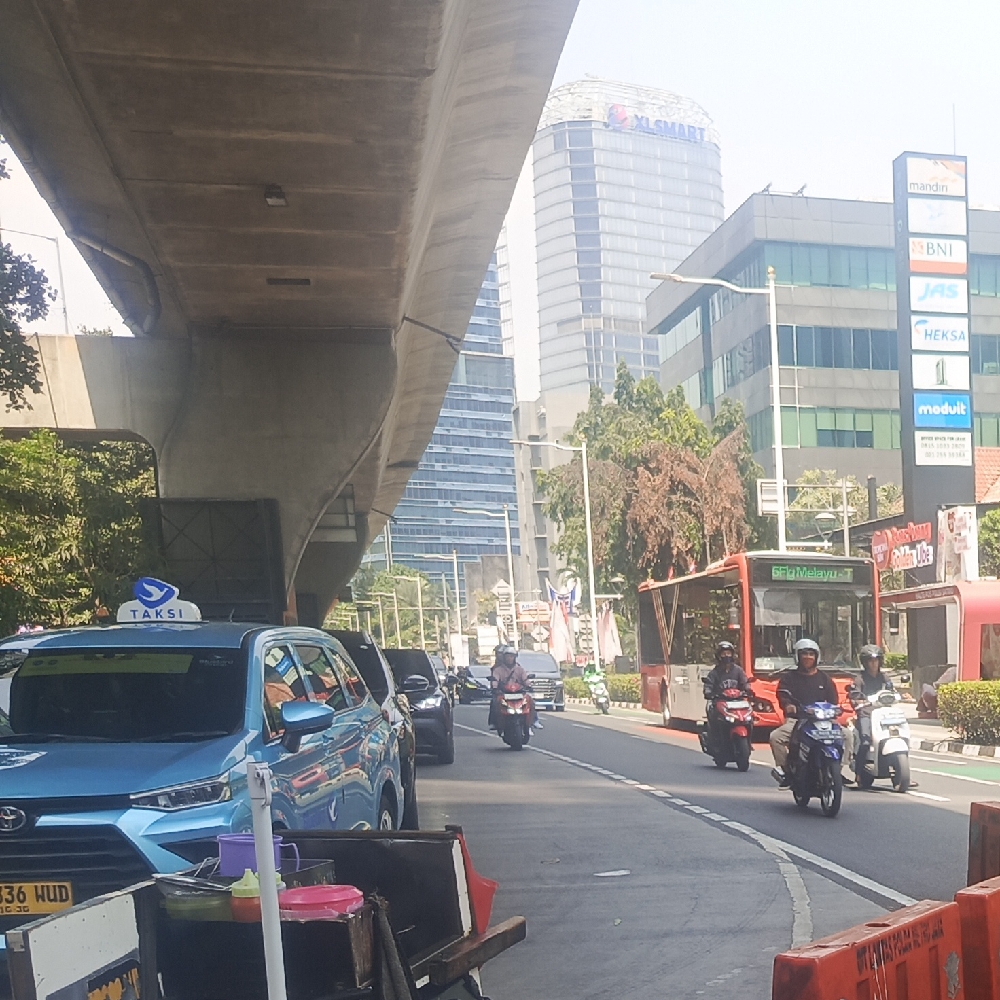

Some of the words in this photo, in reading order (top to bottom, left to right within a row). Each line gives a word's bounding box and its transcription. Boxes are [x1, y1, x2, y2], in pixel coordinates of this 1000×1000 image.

[634, 114, 705, 141] XLSMART
[909, 181, 948, 193] mandiri
[926, 241, 953, 257] BNI
[917, 282, 959, 302] JAS
[924, 329, 966, 342] HEKSA
[918, 401, 967, 415] moduit
[796, 566, 837, 582] Melayu
[130, 608, 183, 619] TAKSI
[0, 885, 26, 904] 36
[34, 884, 70, 903] WUD
